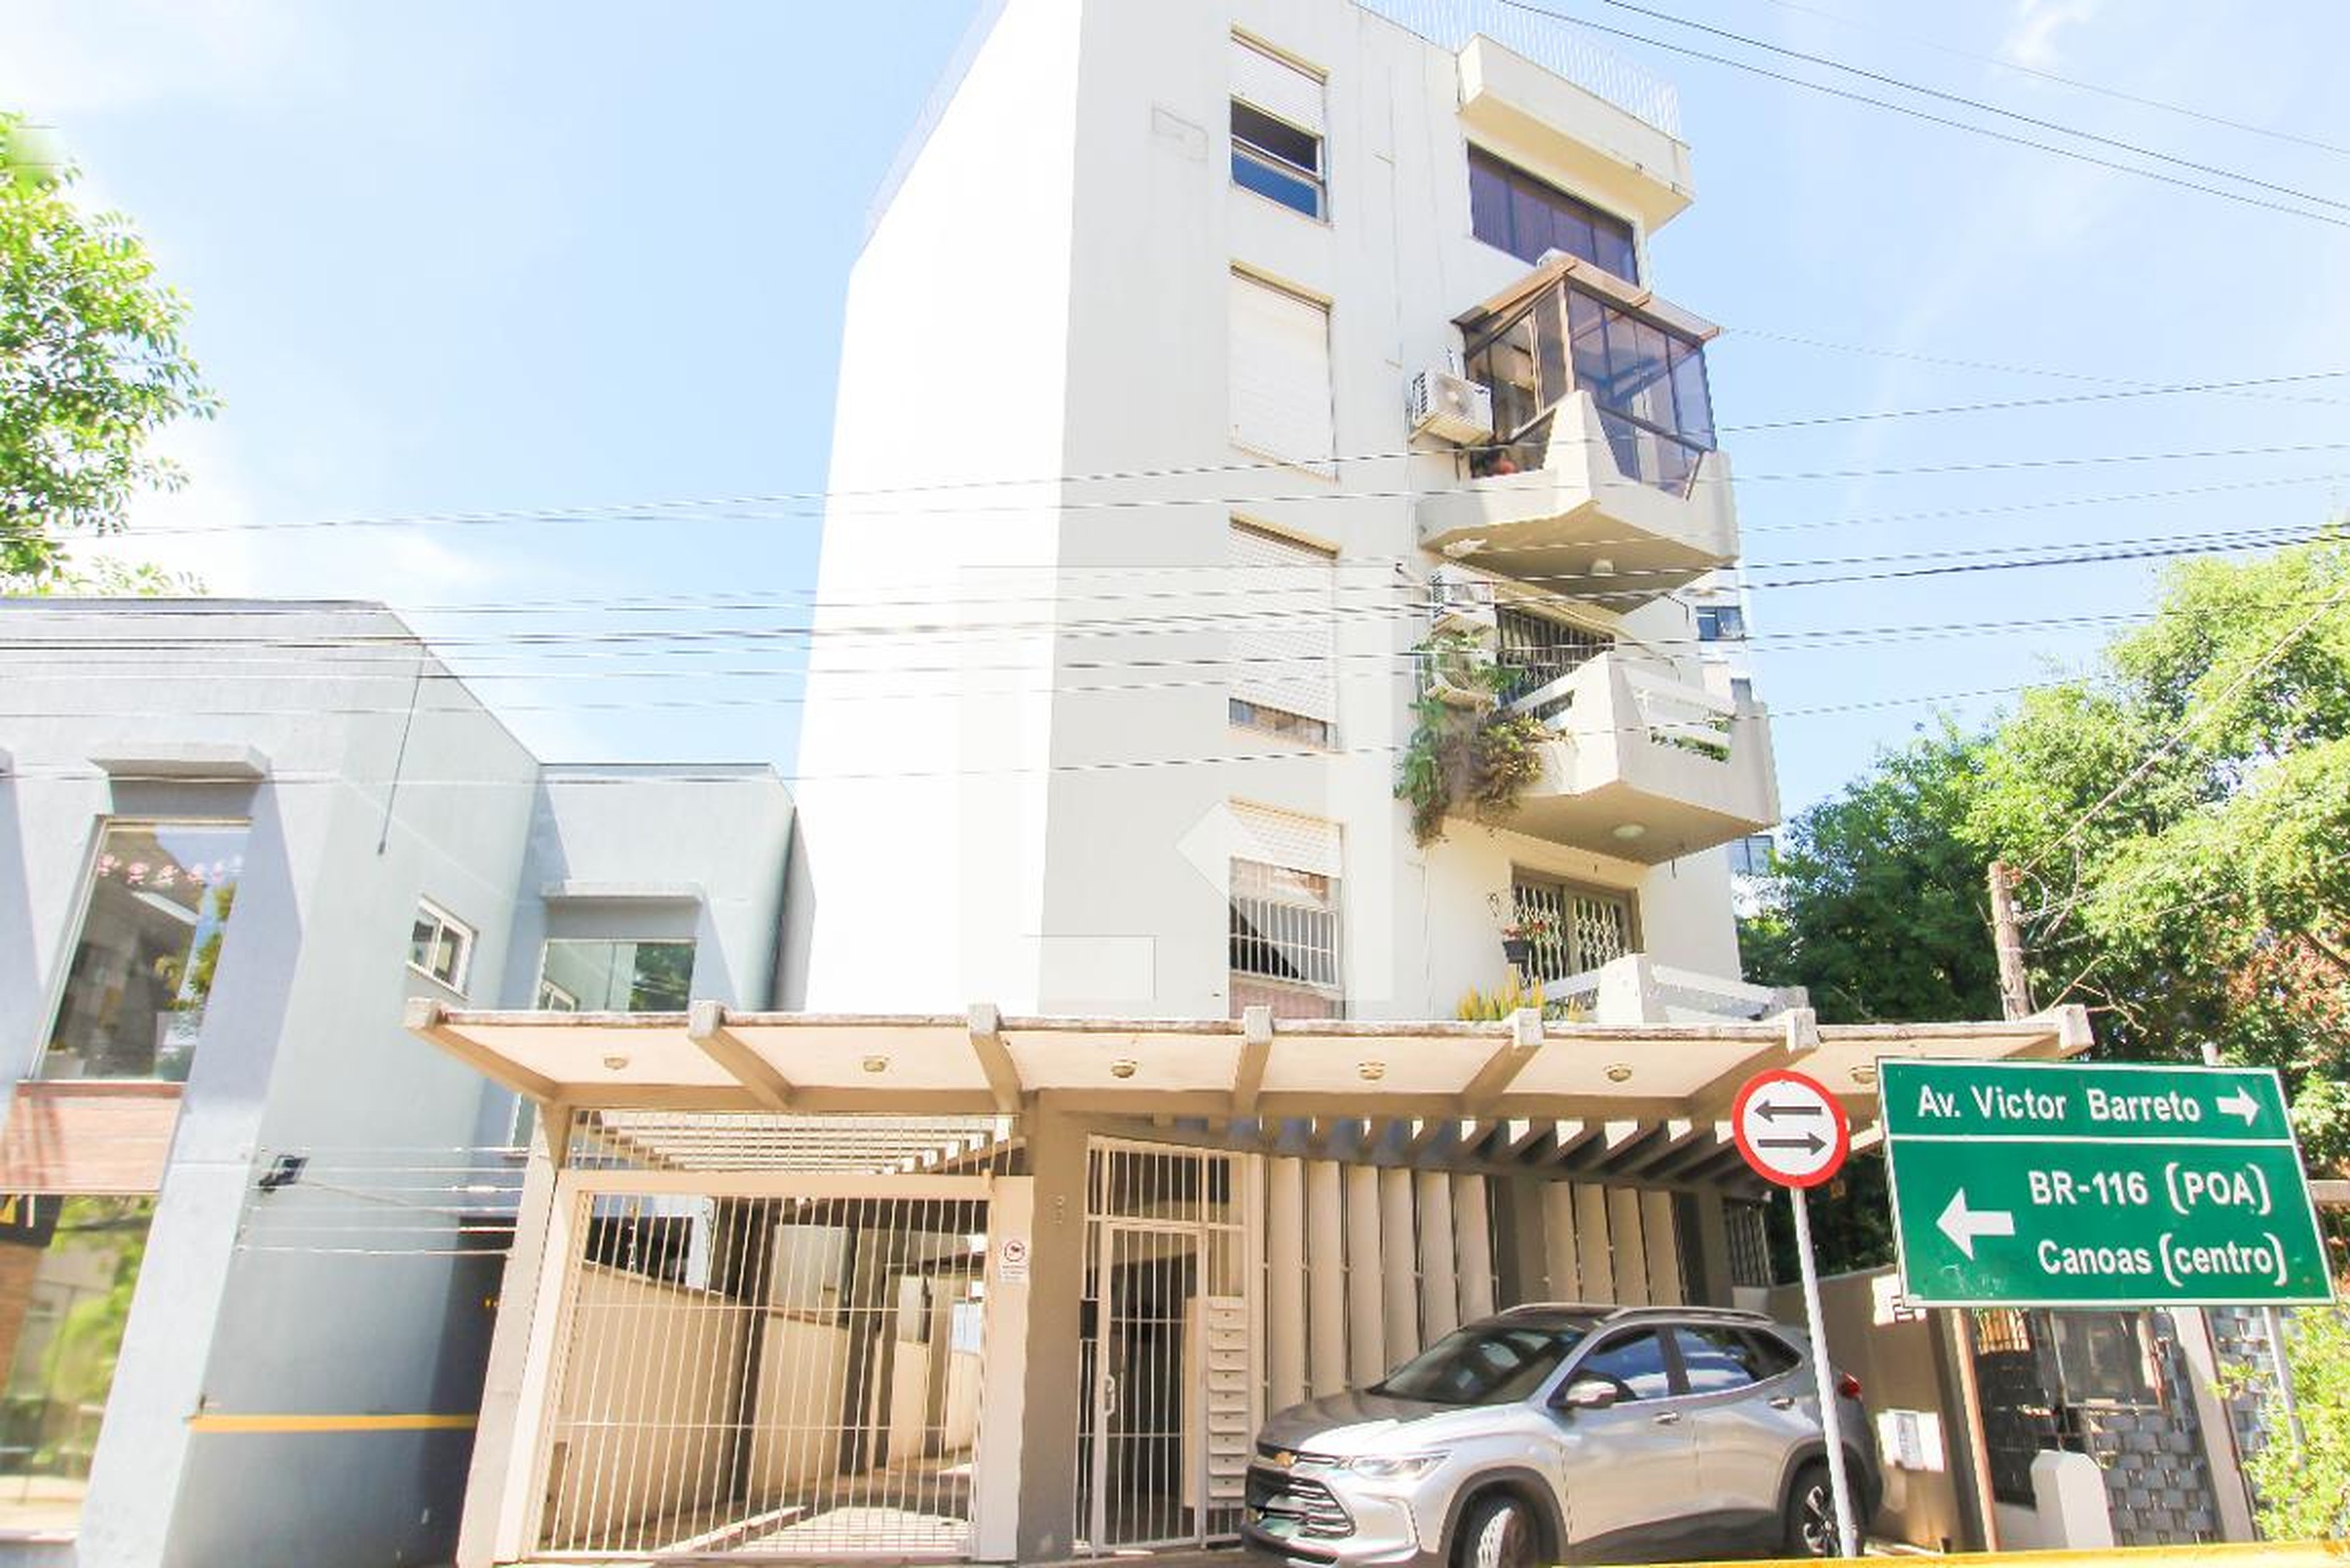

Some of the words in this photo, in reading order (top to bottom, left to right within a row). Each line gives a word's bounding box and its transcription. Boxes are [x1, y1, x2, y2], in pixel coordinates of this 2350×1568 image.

[1919, 1085, 1960, 1117] Av.
[1971, 1086, 2066, 1119] Victor
[2087, 1089, 2201, 1121] Barreto
[2029, 1171, 2148, 1204] BR-116
[2165, 1162, 2271, 1215] (POA)
[2038, 1241, 2152, 1274] Canoas
[2160, 1233, 2287, 1286] (centro)
